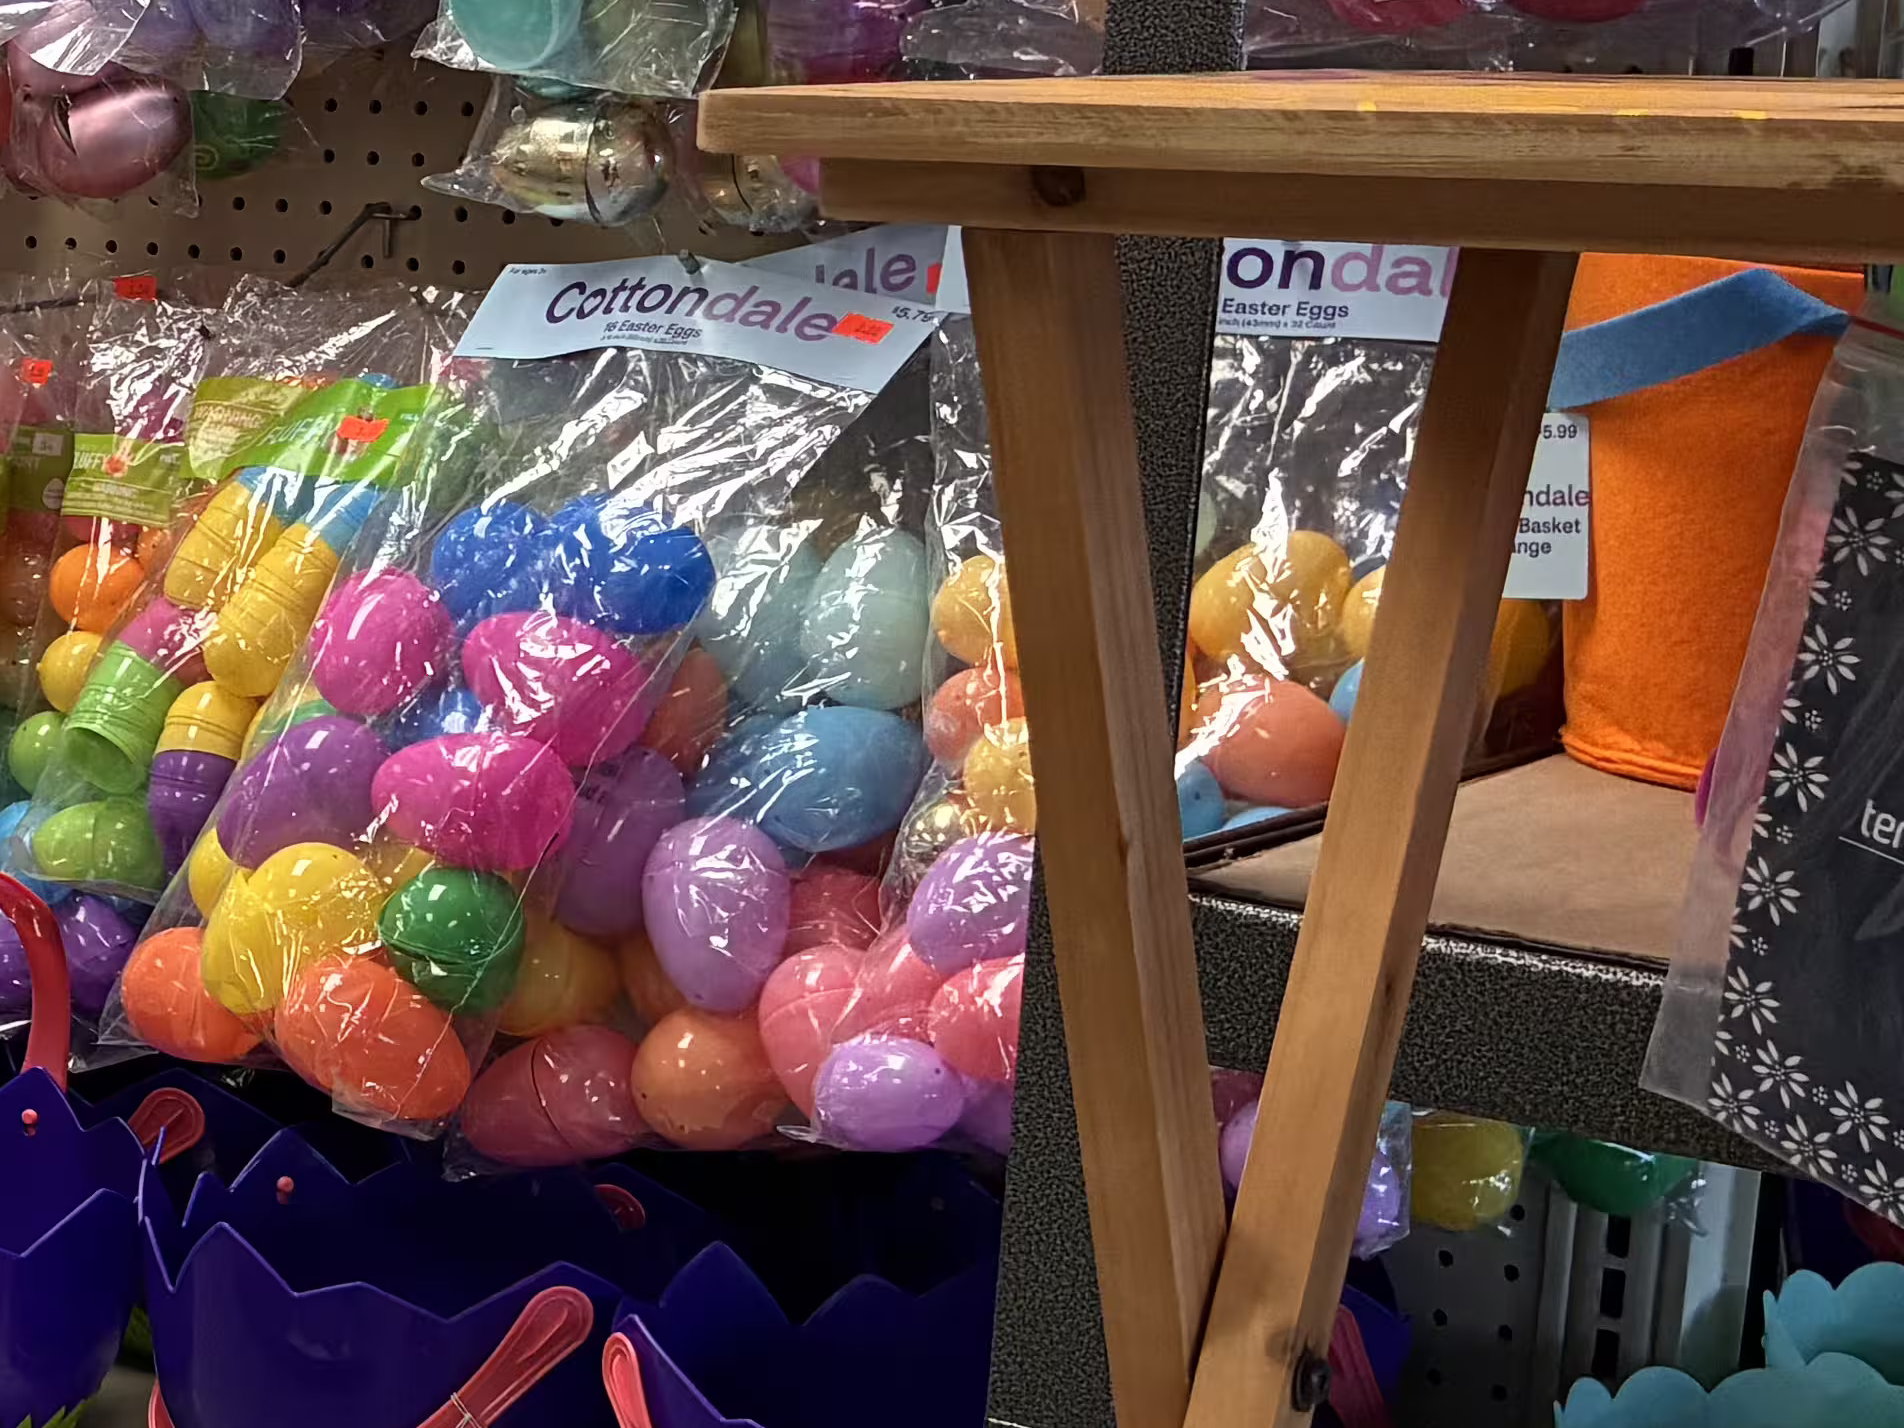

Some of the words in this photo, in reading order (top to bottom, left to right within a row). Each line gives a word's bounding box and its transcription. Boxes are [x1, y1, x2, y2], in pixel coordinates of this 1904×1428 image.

[1226, 244, 1460, 298] ondal
[545, 277, 839, 342] Cottondale
[1222, 298, 1290, 316] Easter
[1296, 302, 1349, 320] Eggs
[619, 321, 661, 337] Easter
[664, 324, 702, 340] Eggs
[1543, 425, 1577, 439] 5.99
[1525, 484, 1590, 507] ndale
[1519, 517, 1581, 534] Basket
